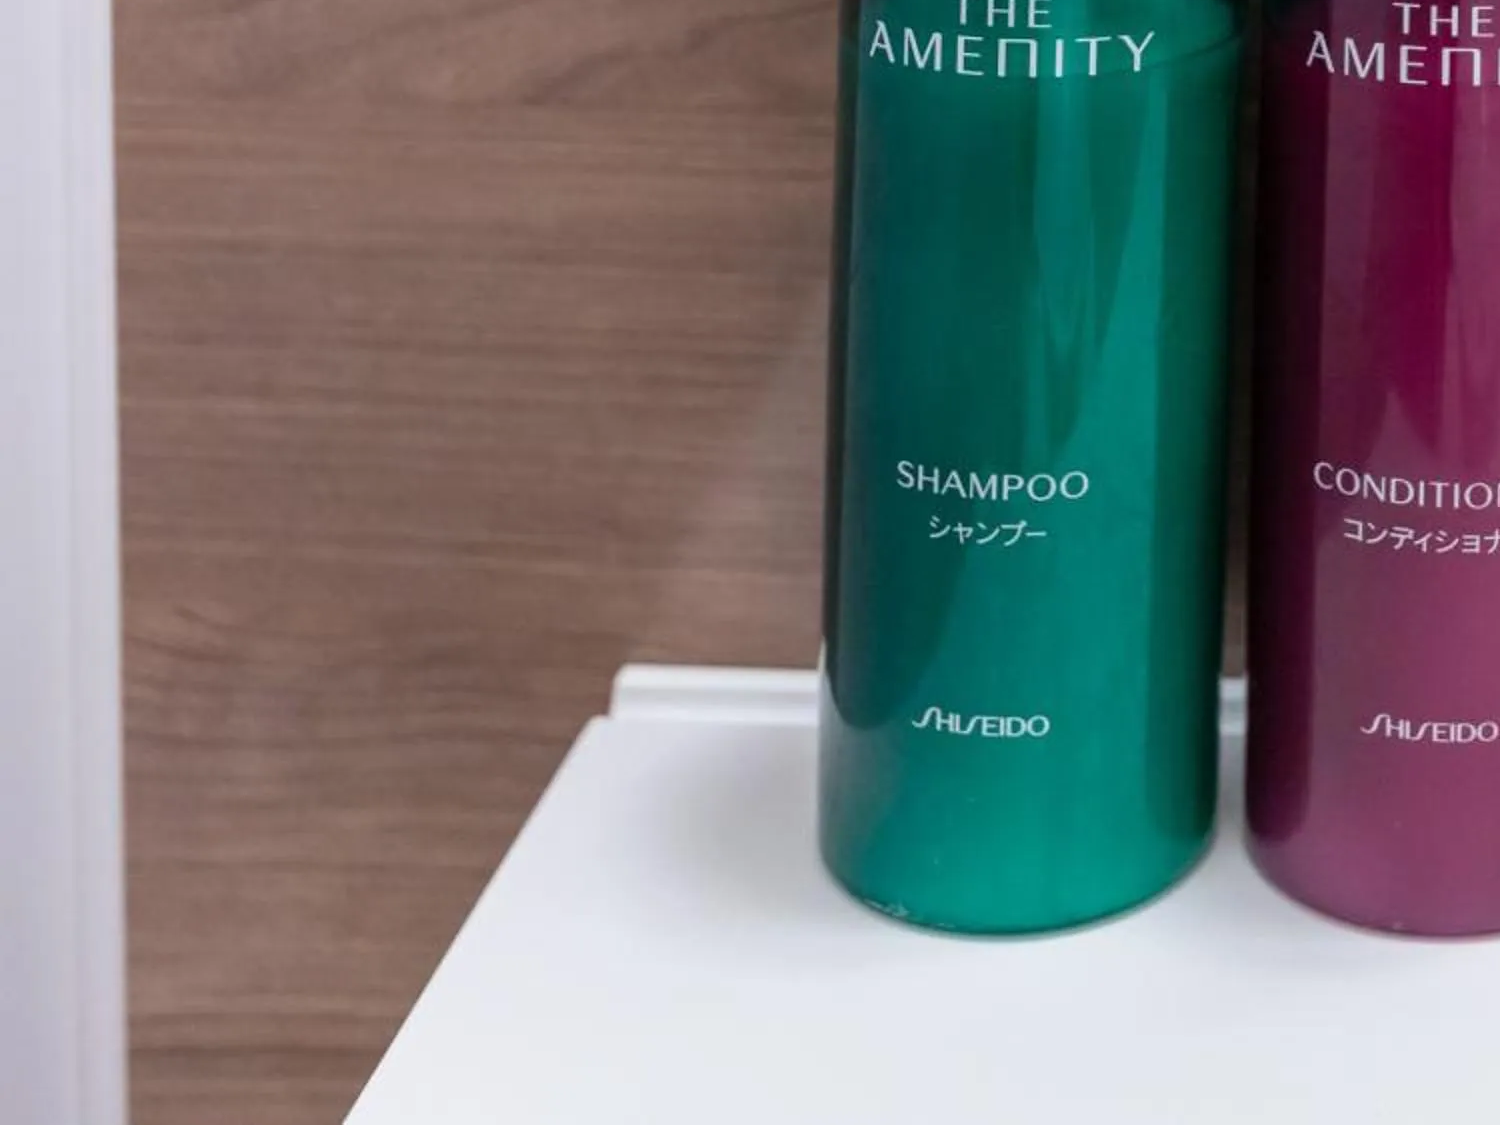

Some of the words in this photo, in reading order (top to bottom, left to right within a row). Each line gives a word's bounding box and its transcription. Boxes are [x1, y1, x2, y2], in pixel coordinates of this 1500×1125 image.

[1391, 1, 1496, 39] THE
[895, 459, 1090, 503] SHAMPOO
[928, 515, 1048, 548] シャンプー
[911, 705, 1051, 740] SHISEIDO
[1360, 712, 1500, 745] SHISEIDO
